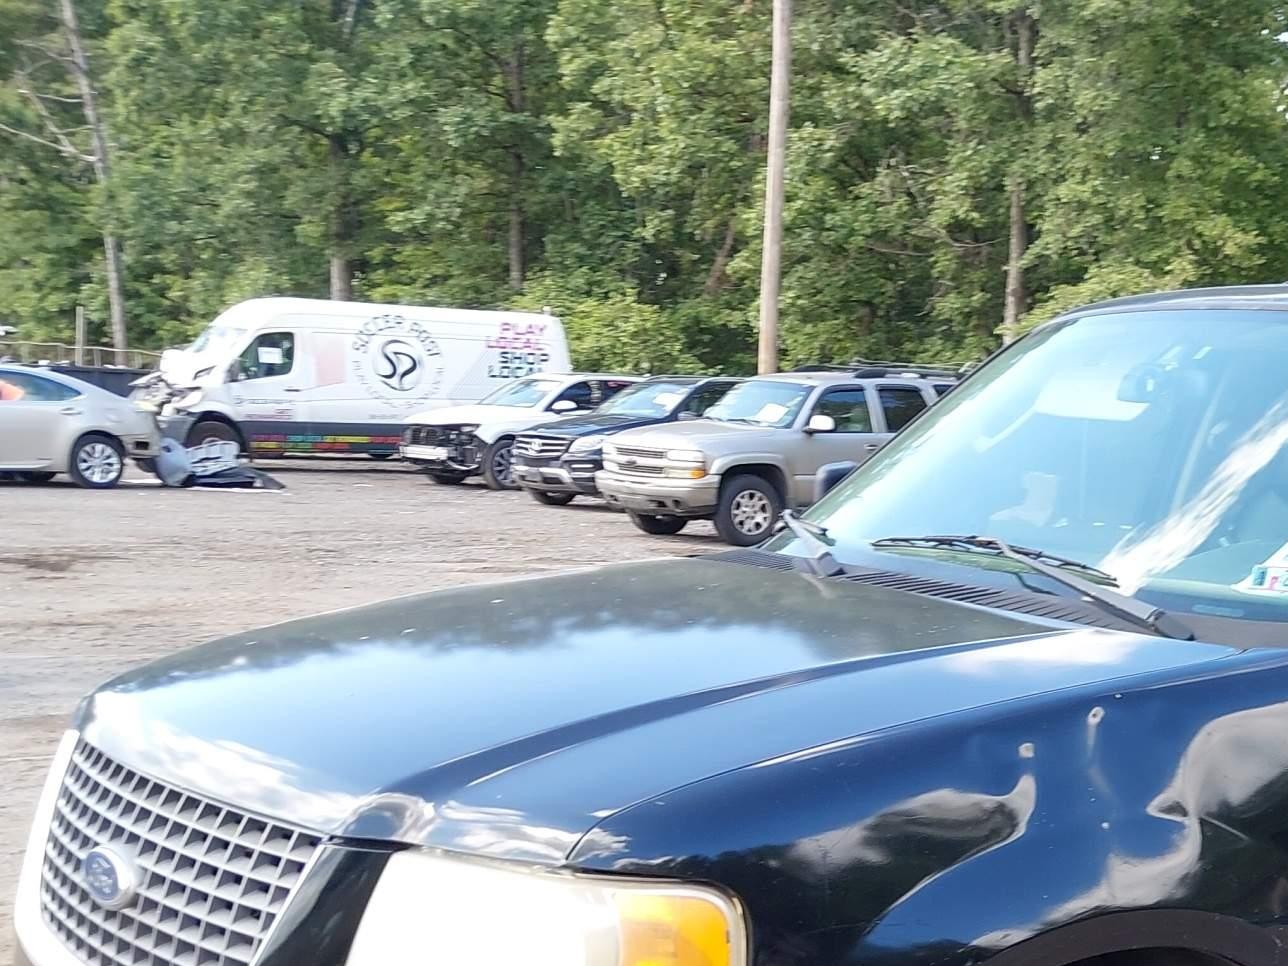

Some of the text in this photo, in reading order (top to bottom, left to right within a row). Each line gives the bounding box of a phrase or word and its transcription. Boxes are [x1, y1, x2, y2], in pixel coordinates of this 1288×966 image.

[500, 322, 548, 336] PLAY
[486, 336, 545, 351] LOCAL
[499, 351, 550, 365] SHOP
